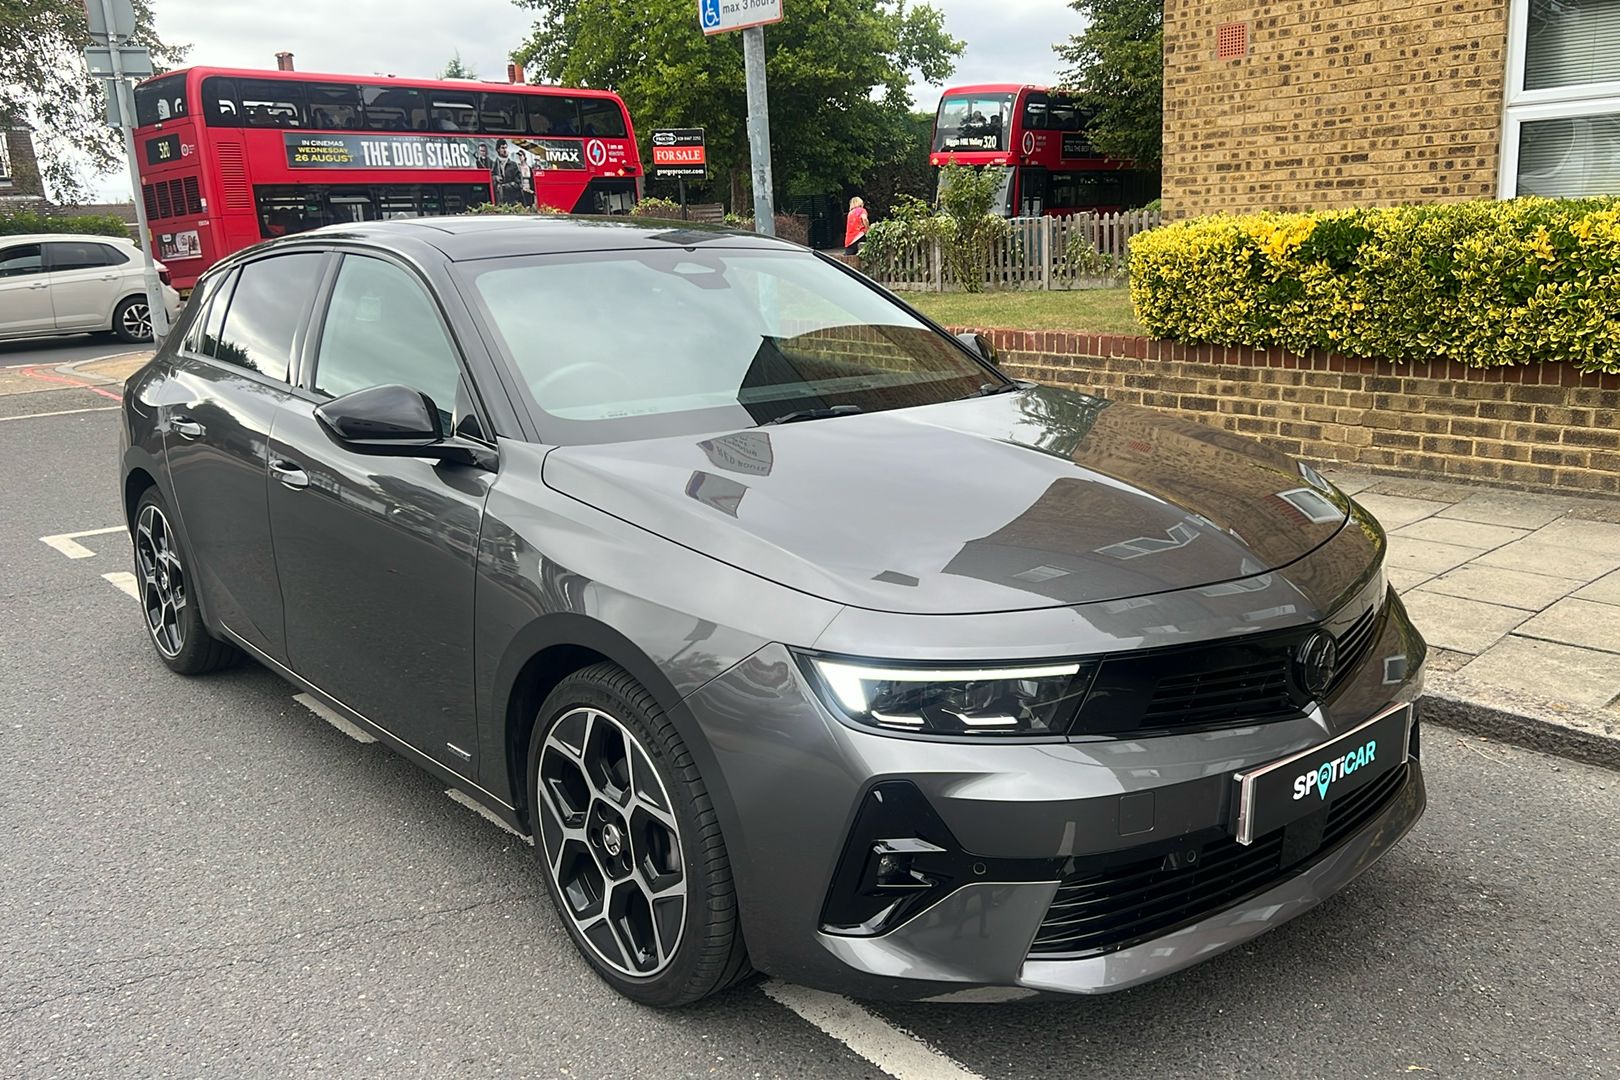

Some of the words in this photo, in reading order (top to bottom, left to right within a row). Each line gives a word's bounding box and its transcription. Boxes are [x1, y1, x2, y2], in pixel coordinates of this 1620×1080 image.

[722, 3, 740, 14] max
[742, 0, 748, 10] 3
[969, 138, 983, 147] Valley
[983, 135, 997, 149] 320
[295, 154, 309, 162] 26
[310, 154, 354, 163] AUGUST
[360, 142, 391, 166] THE
[393, 142, 424, 167] DOG
[425, 143, 471, 167] STARS
[545, 151, 580, 162] IMAX
[656, 150, 676, 161] FOR
[676, 150, 701, 161] SALE
[656, 168, 704, 177] georgeproctor.com
